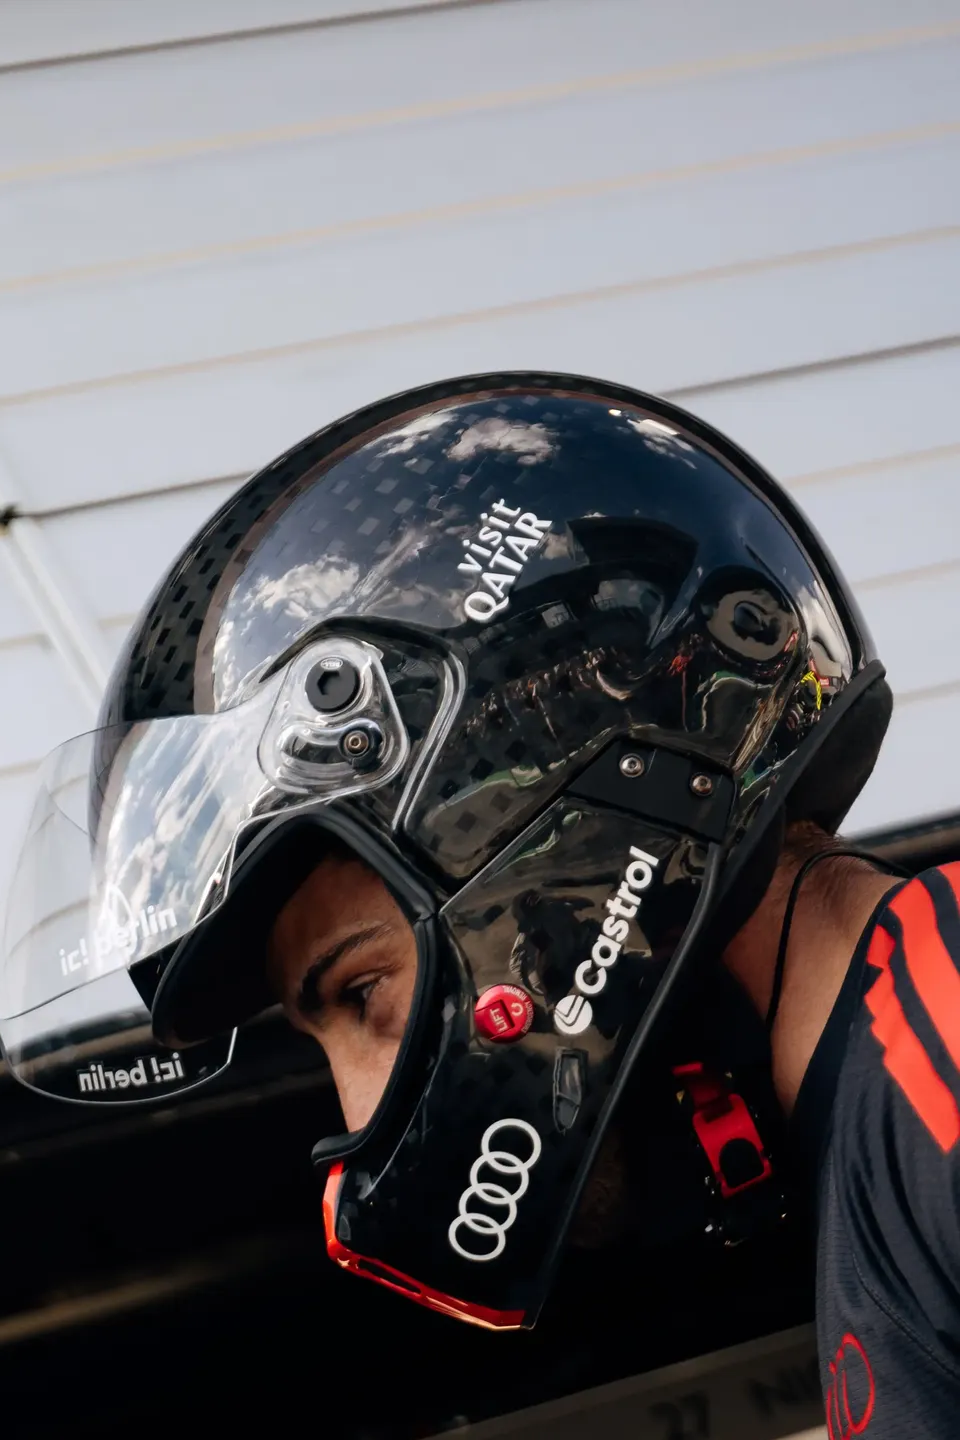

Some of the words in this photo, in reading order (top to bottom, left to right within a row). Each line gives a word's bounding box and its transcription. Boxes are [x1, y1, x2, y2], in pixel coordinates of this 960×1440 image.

[457, 498, 521, 571] visit
[464, 512, 552, 621] QATAR
[58, 938, 89, 976] ic!
[93, 905, 178, 960] berlin
[575, 845, 660, 995] Castrol
[489, 1007, 508, 1033] LIFT
